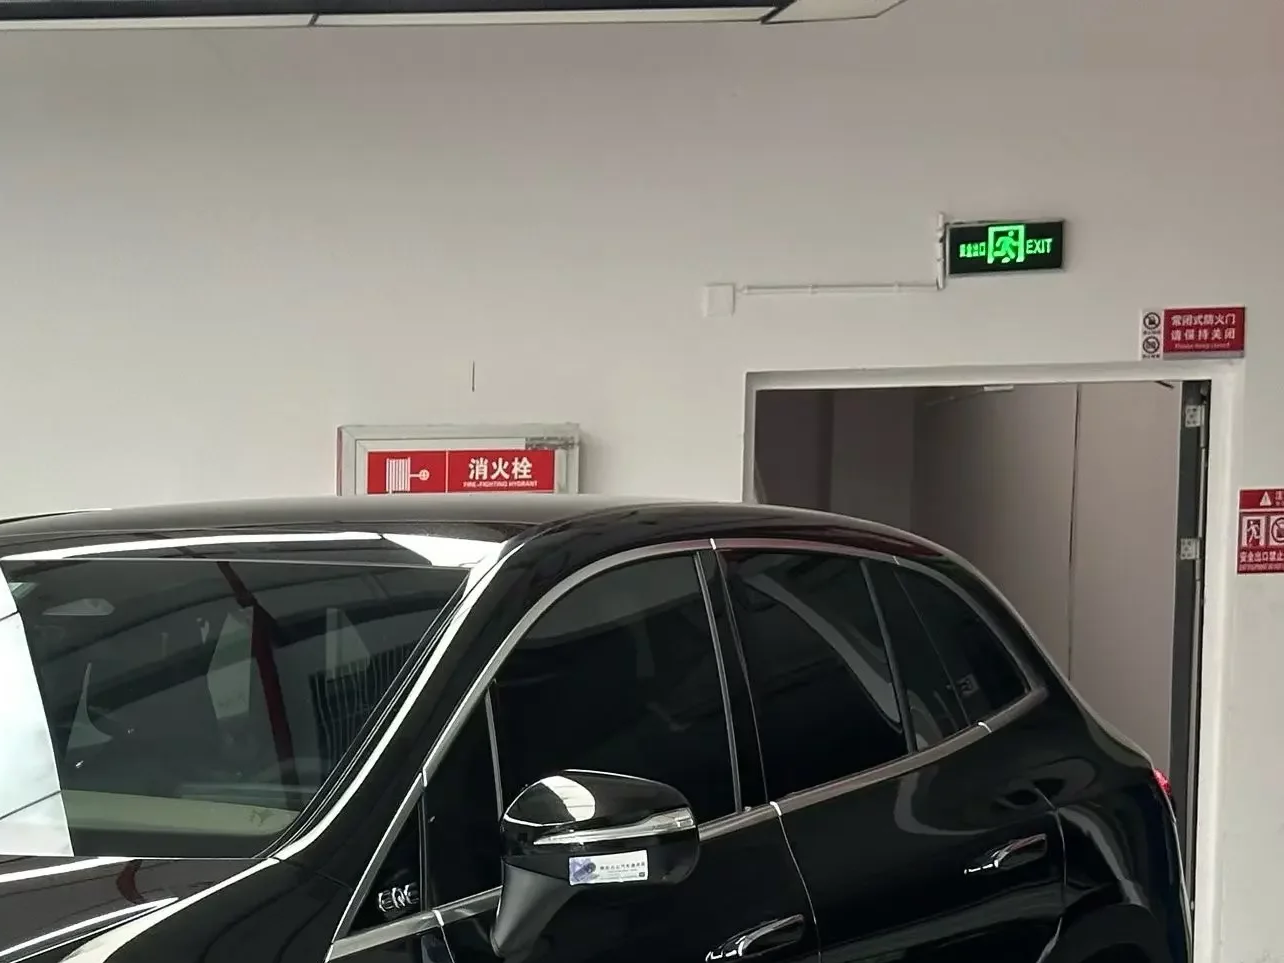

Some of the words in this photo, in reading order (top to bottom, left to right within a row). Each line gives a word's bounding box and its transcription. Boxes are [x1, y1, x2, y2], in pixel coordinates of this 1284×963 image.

[1026, 238, 1053, 254] EXIT
[468, 456, 533, 480] 消火栓
